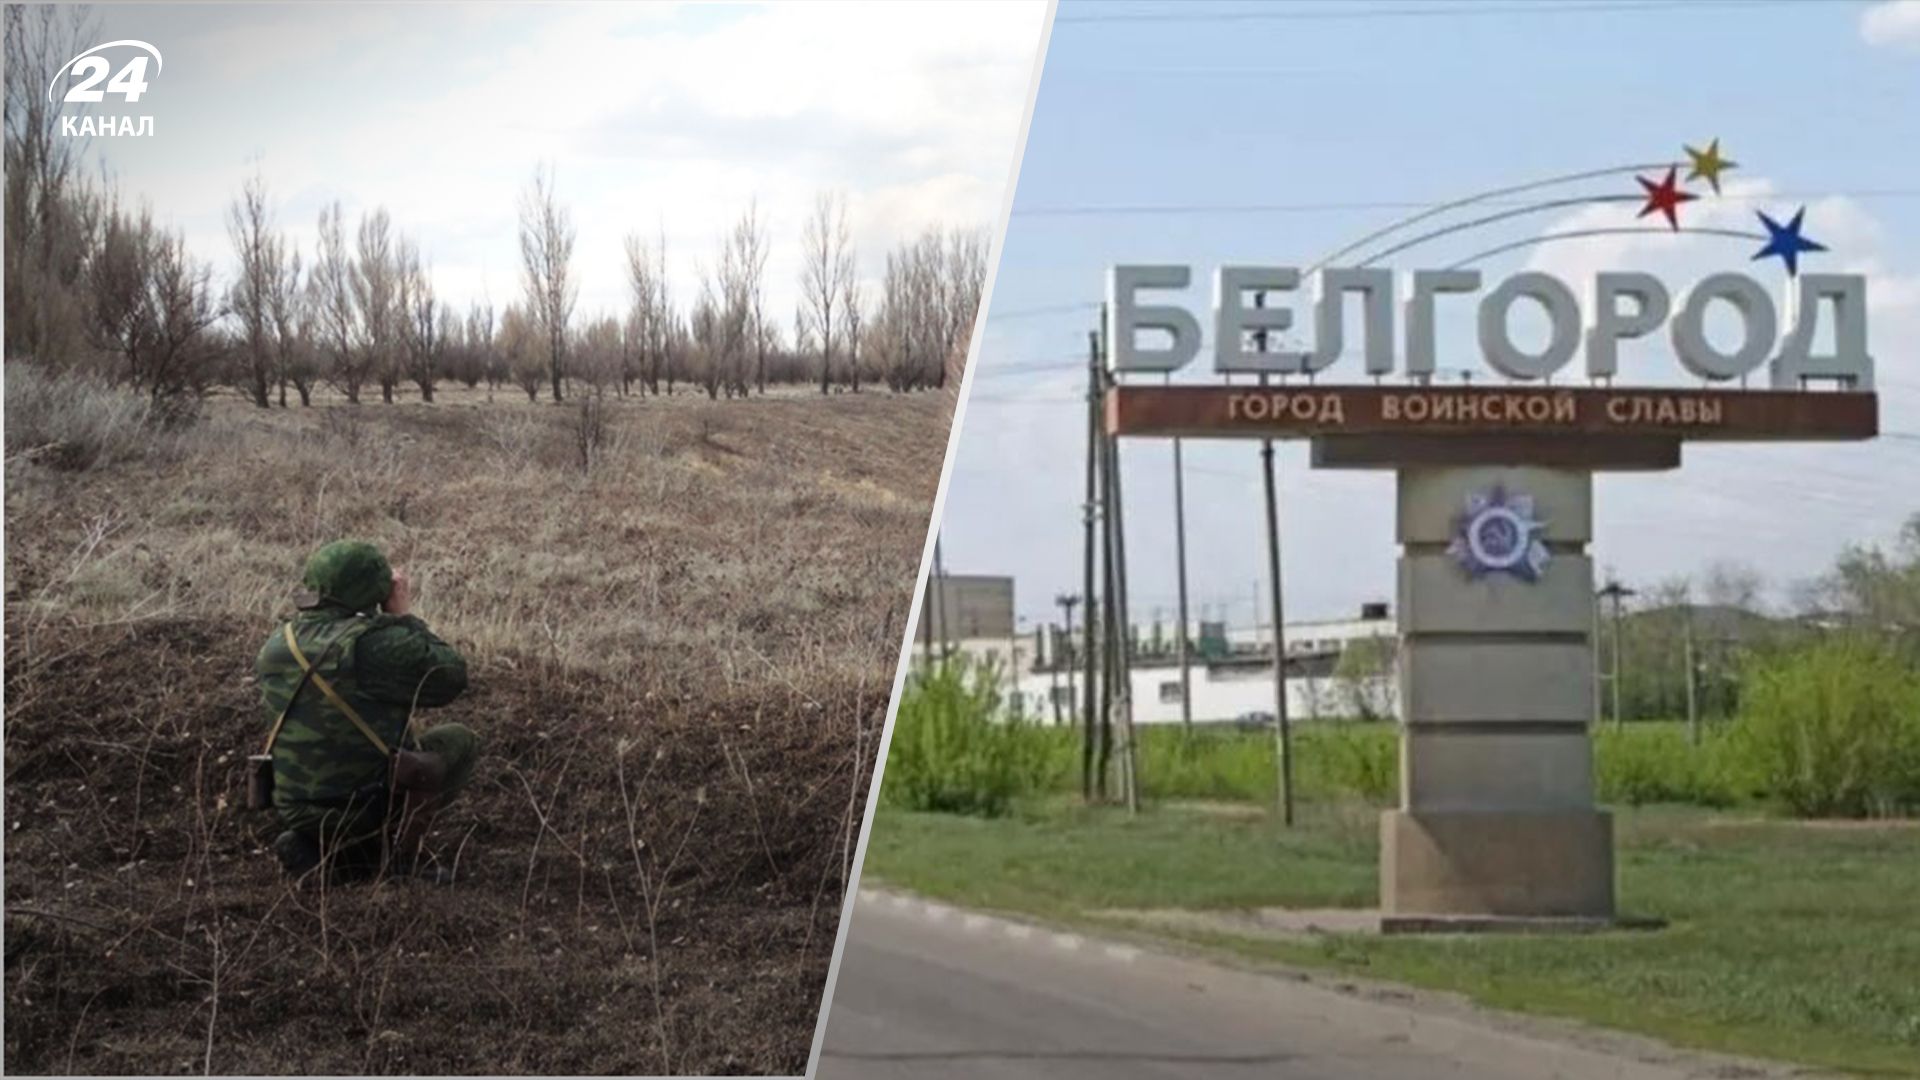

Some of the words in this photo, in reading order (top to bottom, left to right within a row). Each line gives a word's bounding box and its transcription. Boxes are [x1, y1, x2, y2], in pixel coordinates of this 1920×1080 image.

[1106, 264, 1875, 389] БЕЛГОРОД
[1227, 395, 1344, 424] ГОРОД
[1381, 392, 1576, 424] ВОИНСКОЙ
[1606, 397, 1723, 425] СЛАВЫ
